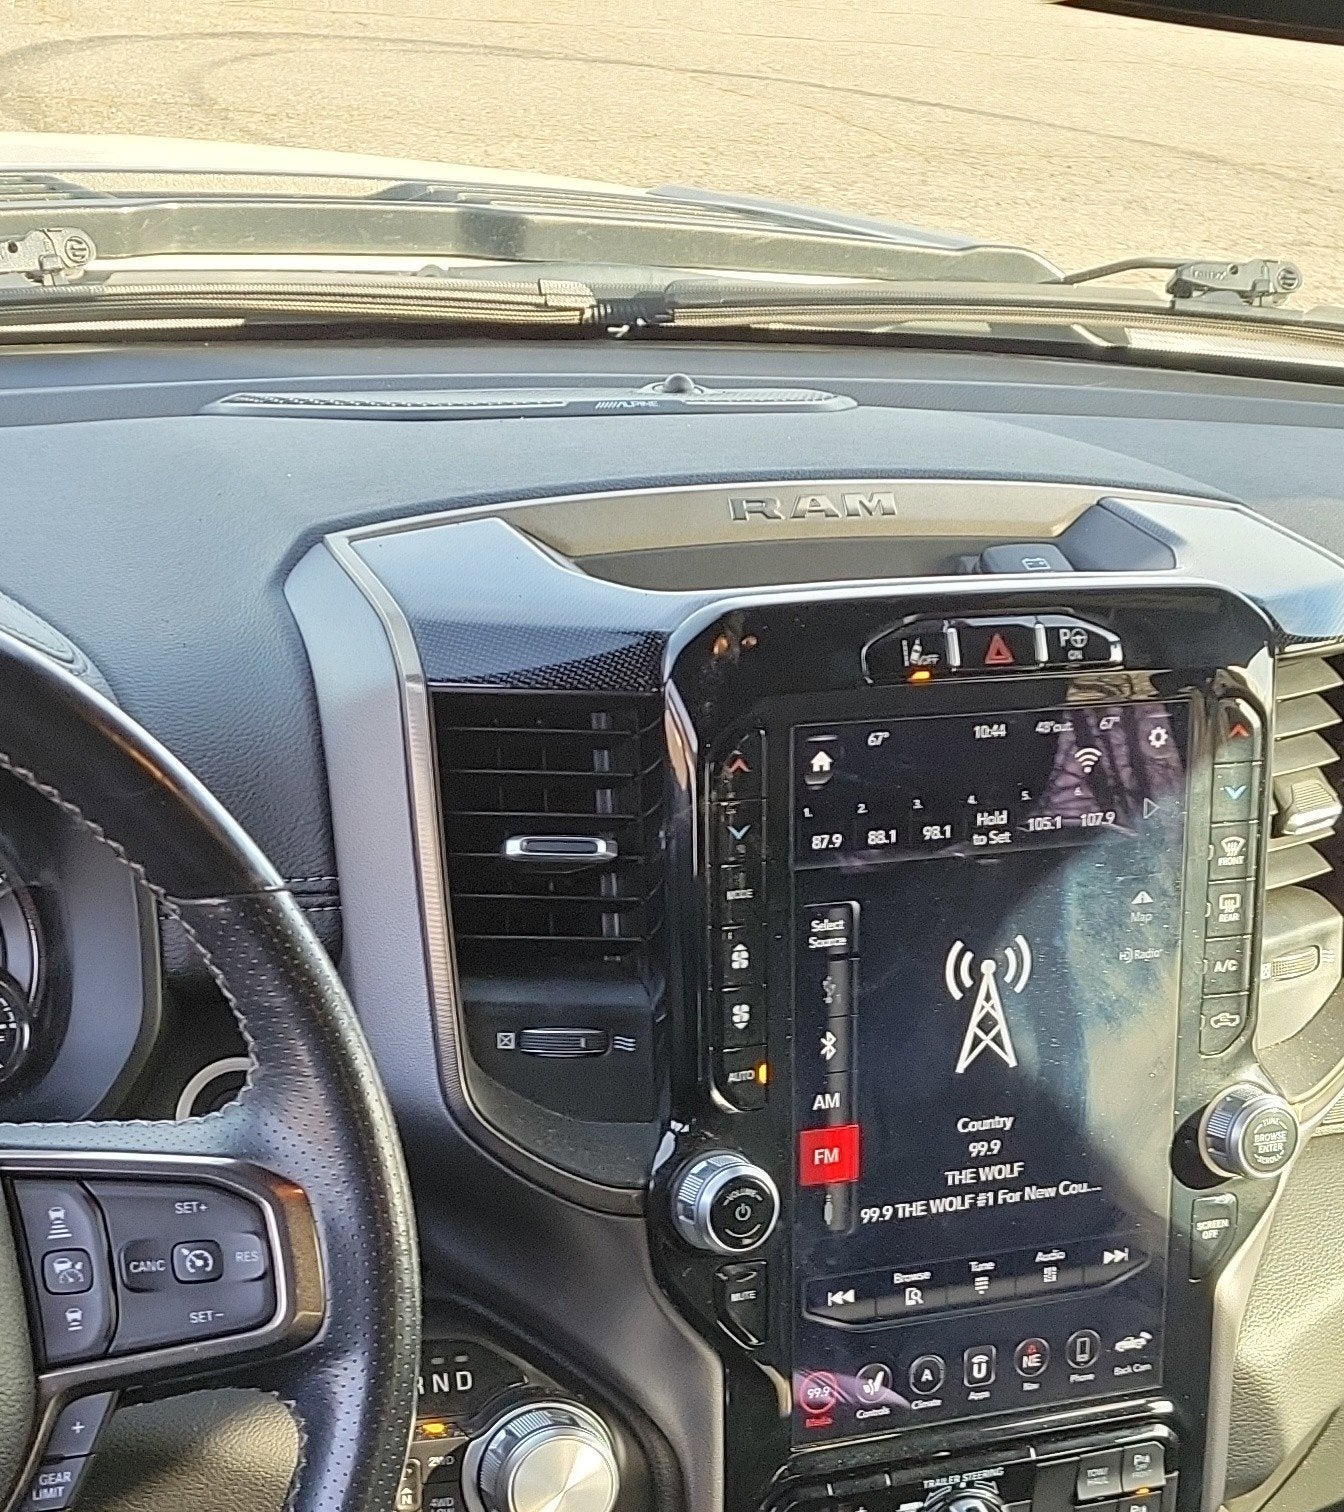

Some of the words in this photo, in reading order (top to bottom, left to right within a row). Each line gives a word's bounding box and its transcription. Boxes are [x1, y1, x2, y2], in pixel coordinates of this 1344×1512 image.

[728, 491, 898, 521] RAM
[973, 723, 1006, 739] 10:44
[976, 810, 1008, 827] Hold
[1027, 816, 1062, 832] 105.1
[1080, 811, 1116, 827] 107.9
[867, 829, 897, 845] 88.1
[922, 824, 952, 841] 98.1
[972, 833, 988, 846] to
[989, 830, 1013, 845] Set
[811, 833, 843, 850] 87.9
[1217, 854, 1244, 866] FRONT
[810, 918, 846, 932] Select
[1130, 911, 1154, 924] Map
[1218, 913, 1240, 923] REAR
[808, 936, 848, 949] Source
[1213, 959, 1240, 973] A/C
[727, 1069, 756, 1083] AUTO
[812, 1092, 841, 1111] AM
[956, 1114, 1016, 1133] Country
[1254, 1130, 1287, 1143] BROWSE
[968, 1139, 1003, 1158] 99.9
[1257, 1141, 1284, 1154] ENTER
[813, 1147, 840, 1166] FM
[944, 1168, 977, 1187] THE
[978, 1161, 1026, 1182] WOLF
[860, 1204, 893, 1225] 99.9
[894, 1199, 928, 1220] THE
[929, 1193, 976, 1215] WOLF
[976, 1190, 994, 1208] #1
[997, 1187, 1022, 1206] For
[1024, 1183, 1058, 1202] New
[1196, 1218, 1229, 1231] SCREEN
[1202, 1230, 1219, 1240] OFF
[234, 1250, 259, 1263] RES
[1035, 1249, 1066, 1263] Audio
[129, 1258, 166, 1273] CANC
[969, 1261, 996, 1272] Tune
[893, 1271, 932, 1285] Browse
[730, 1290, 757, 1303] MUTE
[1022, 1353, 1042, 1368] NE
[432, 1373, 450, 1394] N
[457, 1370, 473, 1392] D
[807, 1385, 832, 1400] 99.9
[856, 1405, 891, 1419] Controls
[38, 1471, 72, 1487] GEAR
[922, 1474, 961, 1489] TRAILER
[961, 1466, 1005, 1482] STEERING
[32, 1485, 65, 1501] LIMIT
[401, 1493, 413, 1506] N
